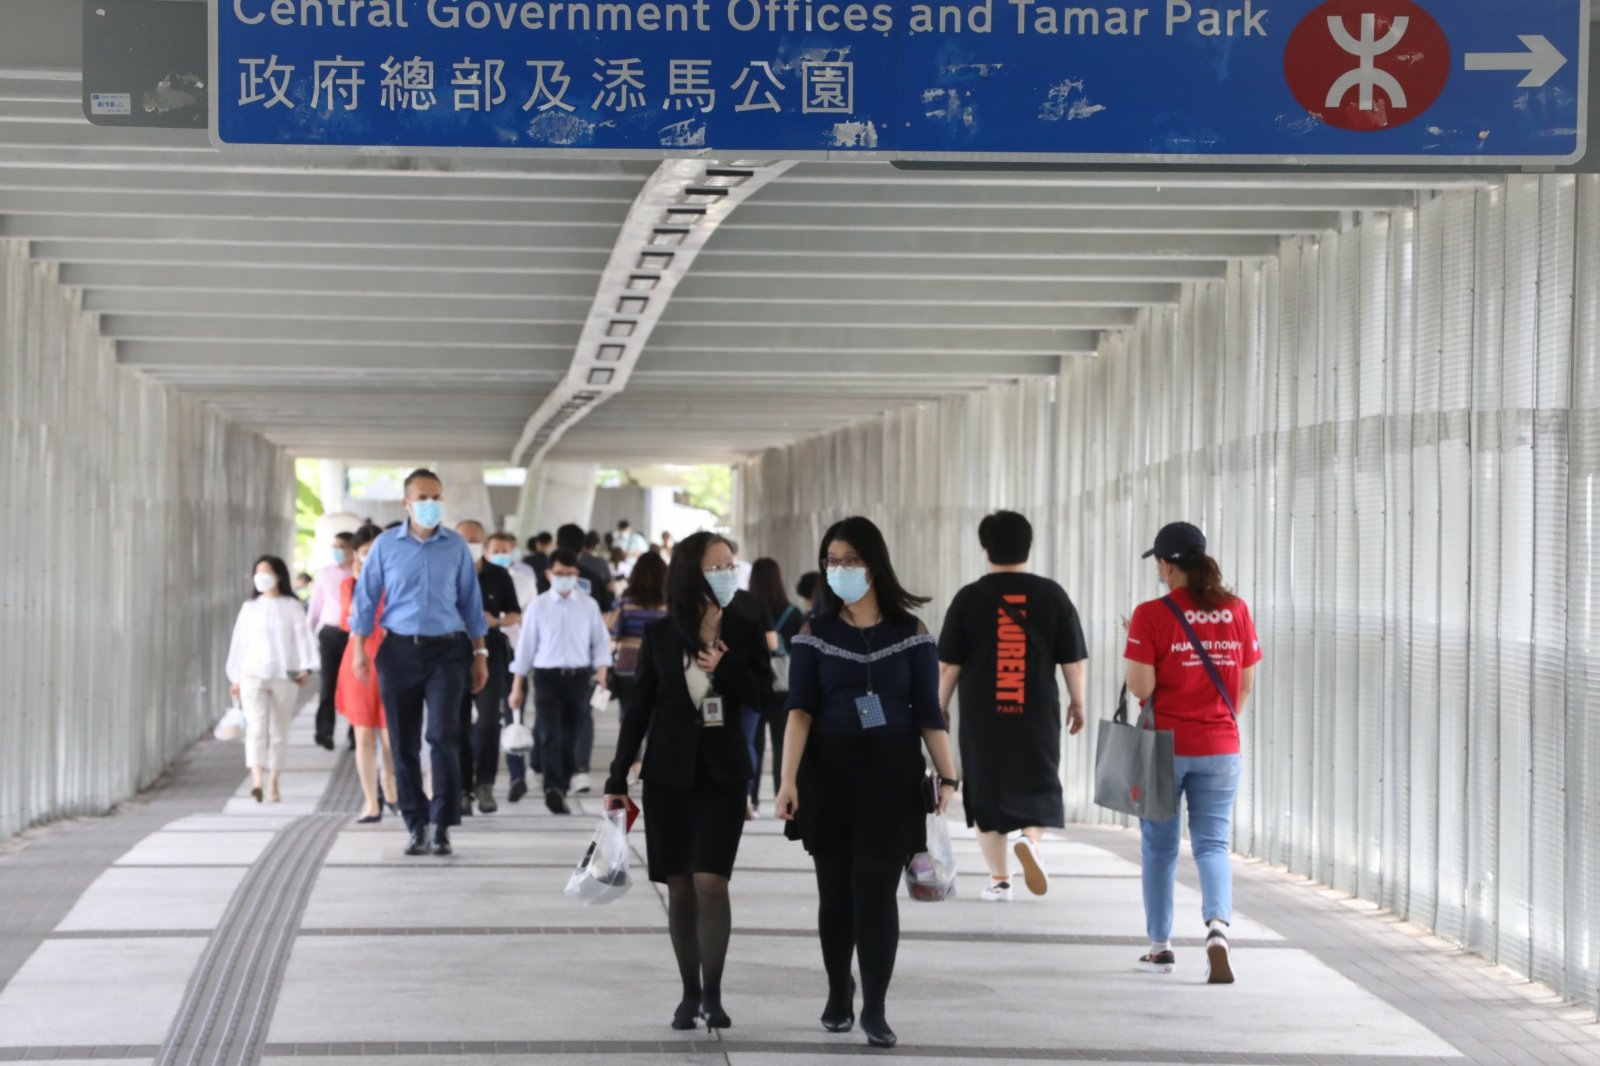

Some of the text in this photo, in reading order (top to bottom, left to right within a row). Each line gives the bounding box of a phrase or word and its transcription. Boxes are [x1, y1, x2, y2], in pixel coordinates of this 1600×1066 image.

[234, 0, 1268, 37] Central Government Offices and Tamar Park
[237, 54, 855, 115] 政府總部及添馬公園
